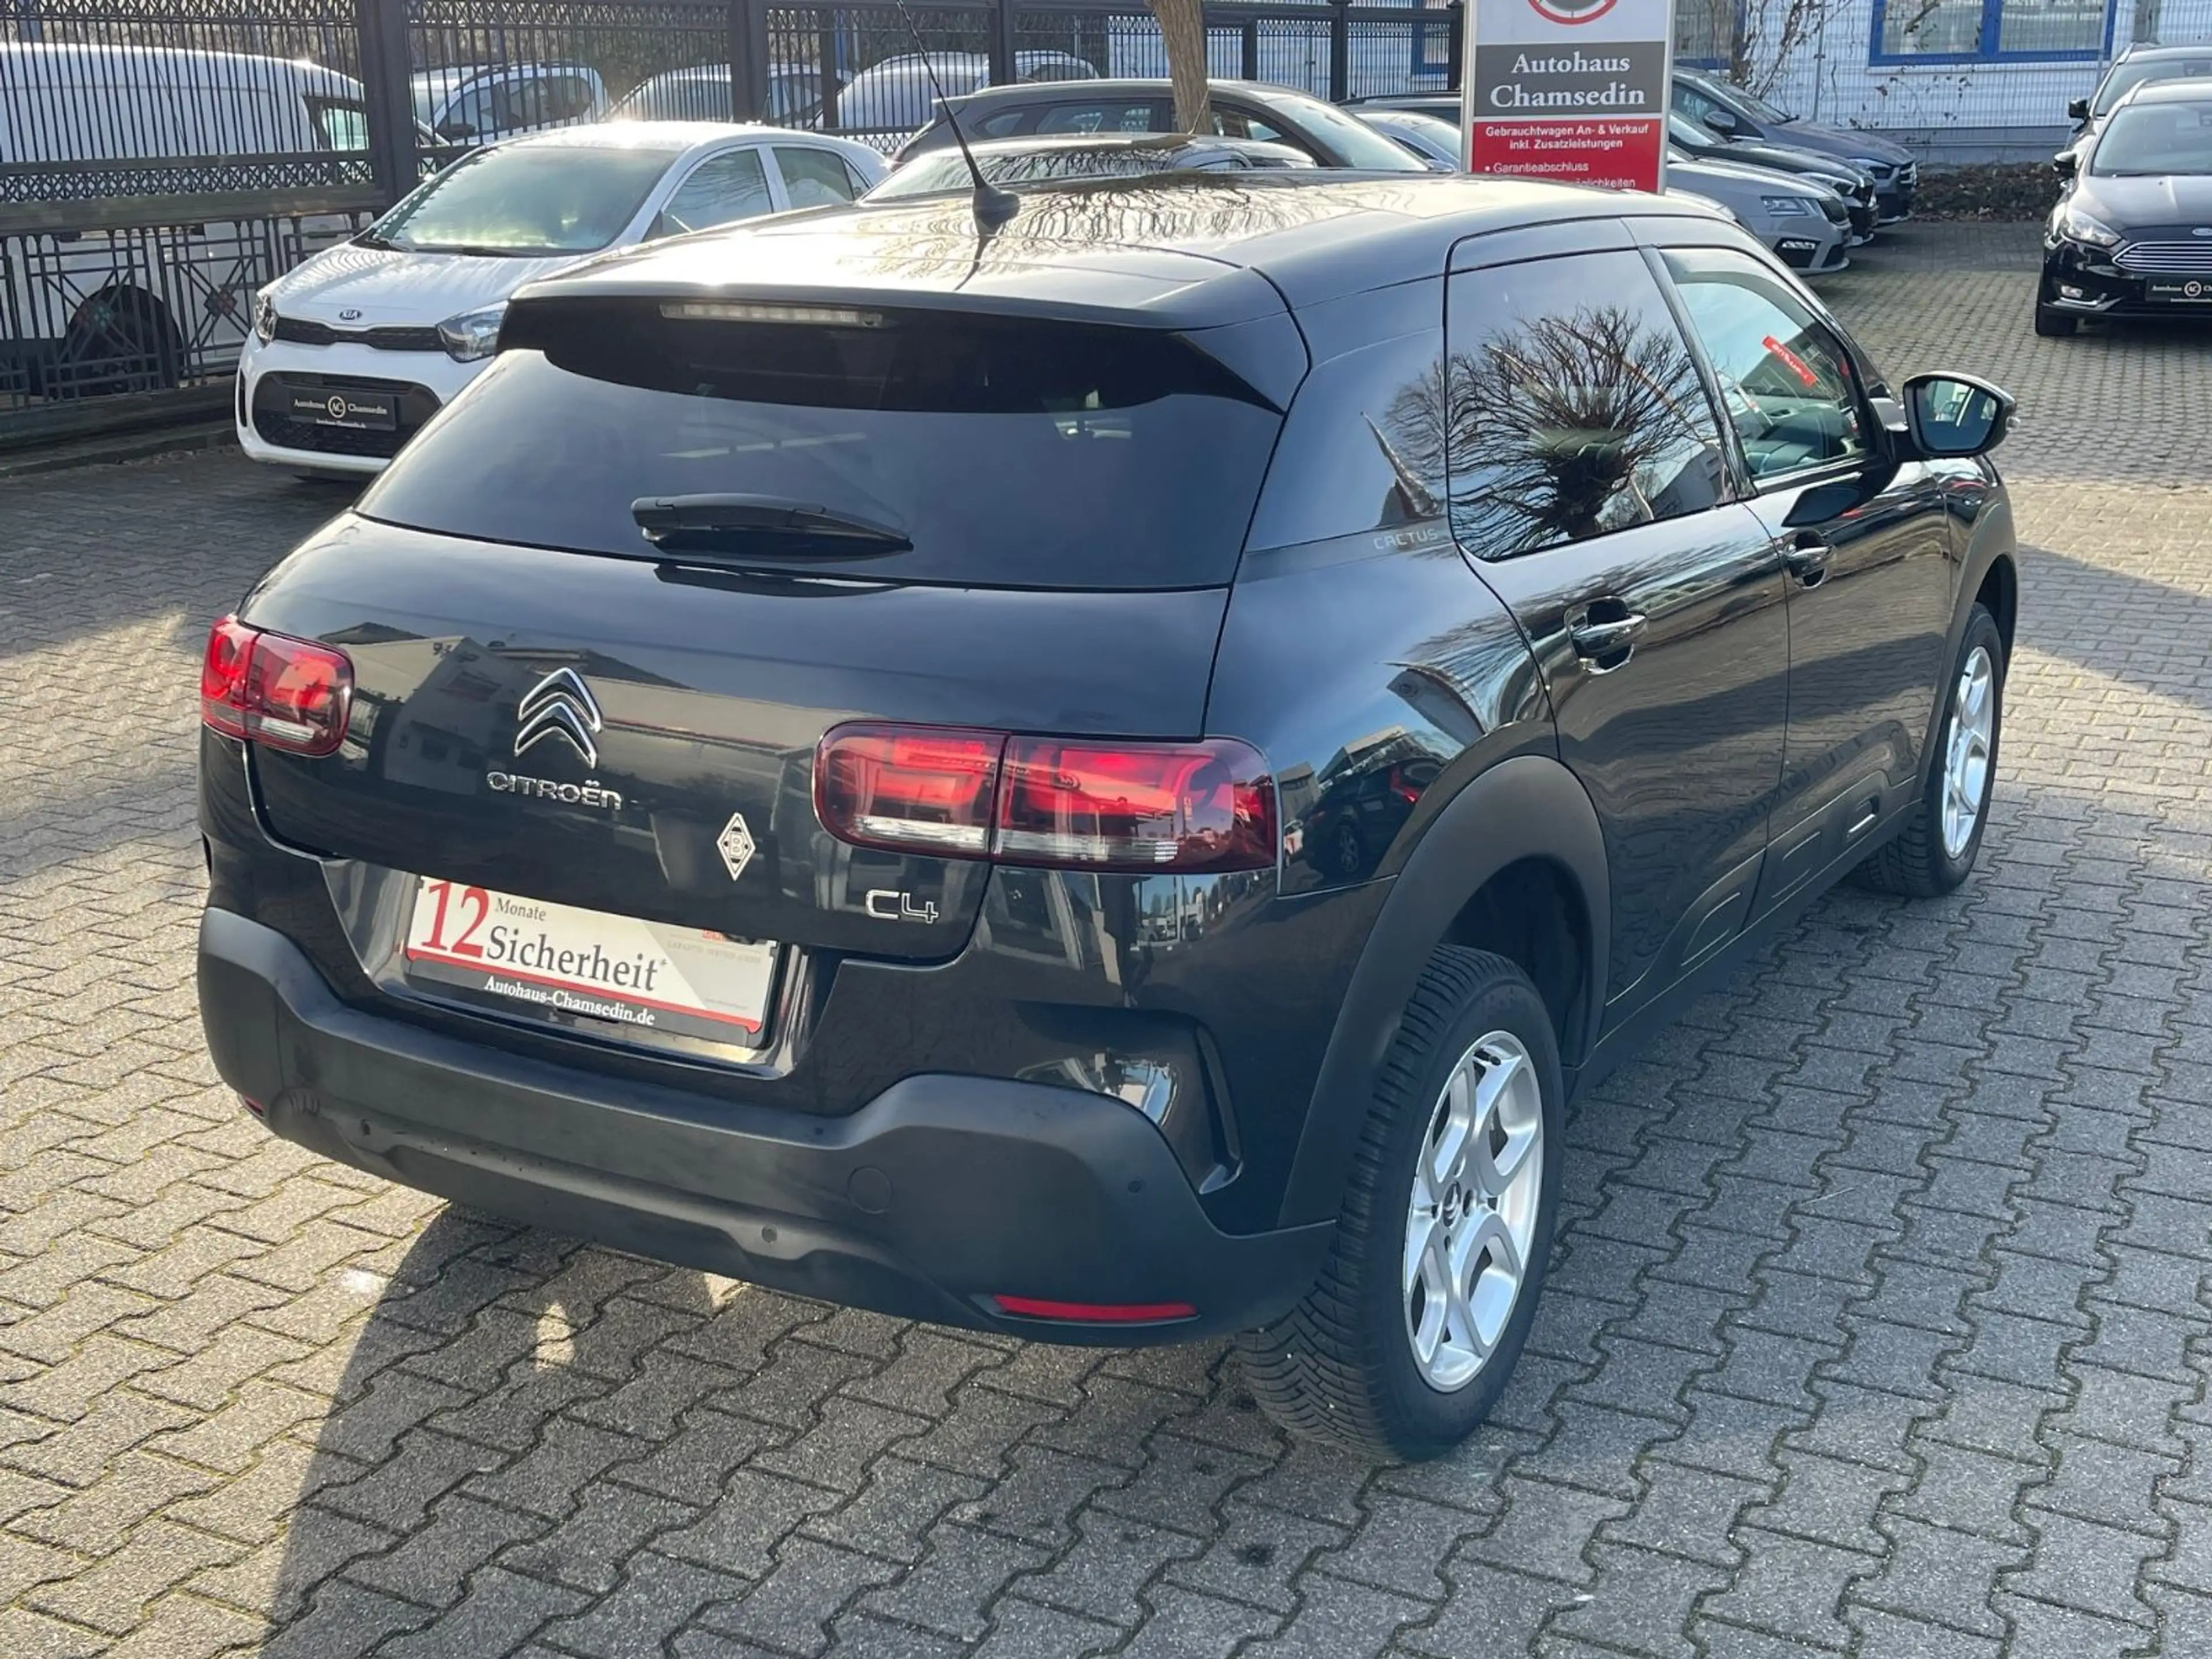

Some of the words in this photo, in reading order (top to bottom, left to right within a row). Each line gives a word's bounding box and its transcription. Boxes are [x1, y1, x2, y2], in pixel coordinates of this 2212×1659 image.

[1512, 51, 1630, 74] Autohaus
[1490, 82, 1645, 108] Chamsedin
[1486, 127, 1574, 138] Gebrauchtwagen
[1576, 125, 1595, 135] An-
[1597, 125, 1605, 134] &
[1609, 123, 1649, 134] Verkauf
[1509, 141, 1531, 150] inkl.
[1493, 162, 1589, 173] Garantieabschluss
[1373, 528, 1438, 550] CACTUS
[487, 771, 622, 810] CITROËN
[495, 897, 547, 922] Monate
[865, 889, 939, 924] C4
[421, 881, 489, 959] 12
[484, 975, 656, 1026] Autohaus-Chamsedin.de
